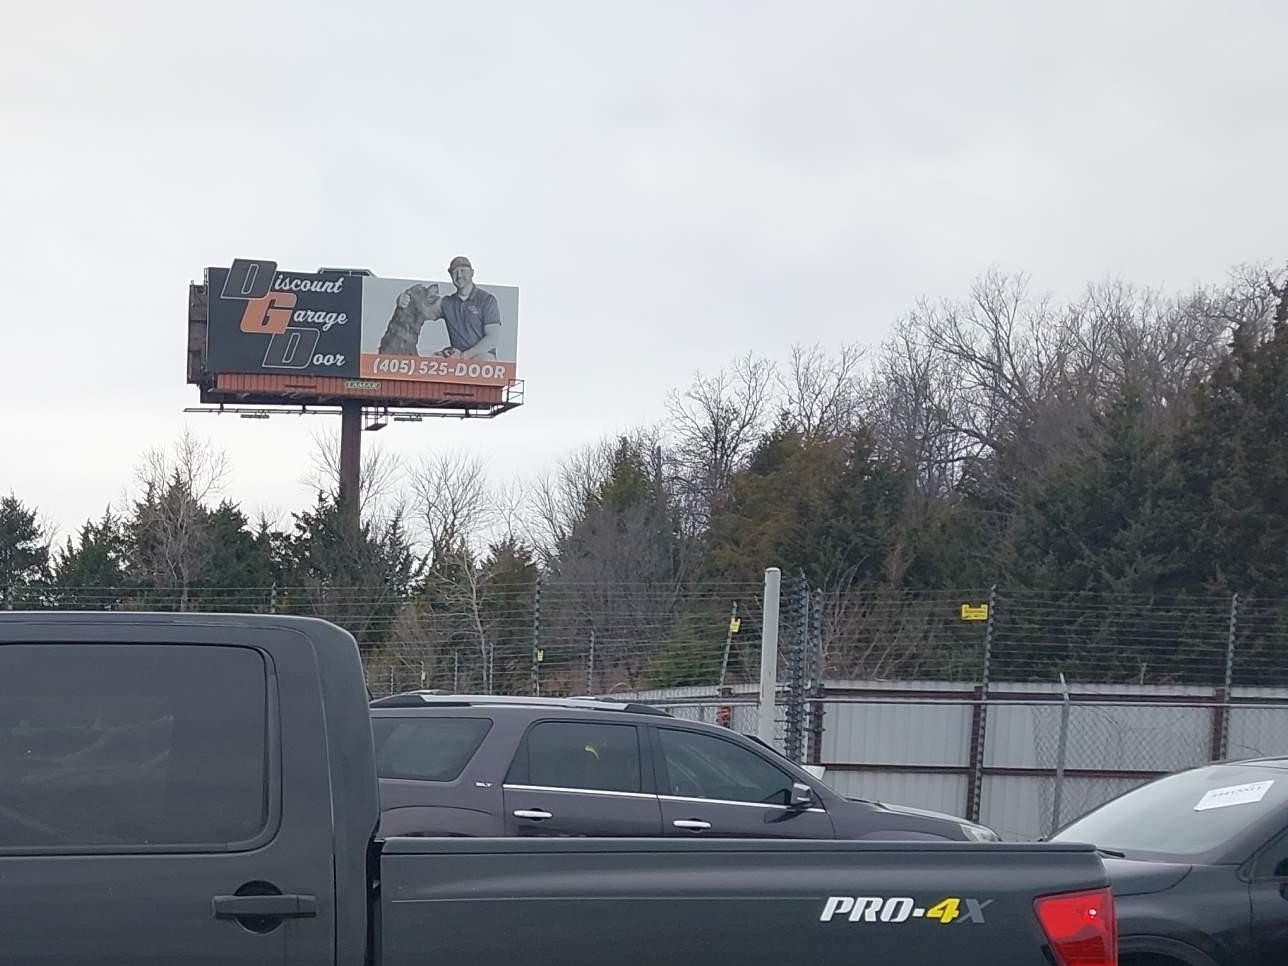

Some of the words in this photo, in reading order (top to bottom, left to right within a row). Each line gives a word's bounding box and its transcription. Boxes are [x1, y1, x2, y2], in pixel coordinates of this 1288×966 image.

[220, 258, 344, 300] Discount
[240, 291, 348, 334] Garage
[262, 326, 346, 369] Door
[373, 358, 415, 375] (405)
[419, 361, 506, 379] 525-DOOR
[820, 896, 994, 924] PRO-4X
